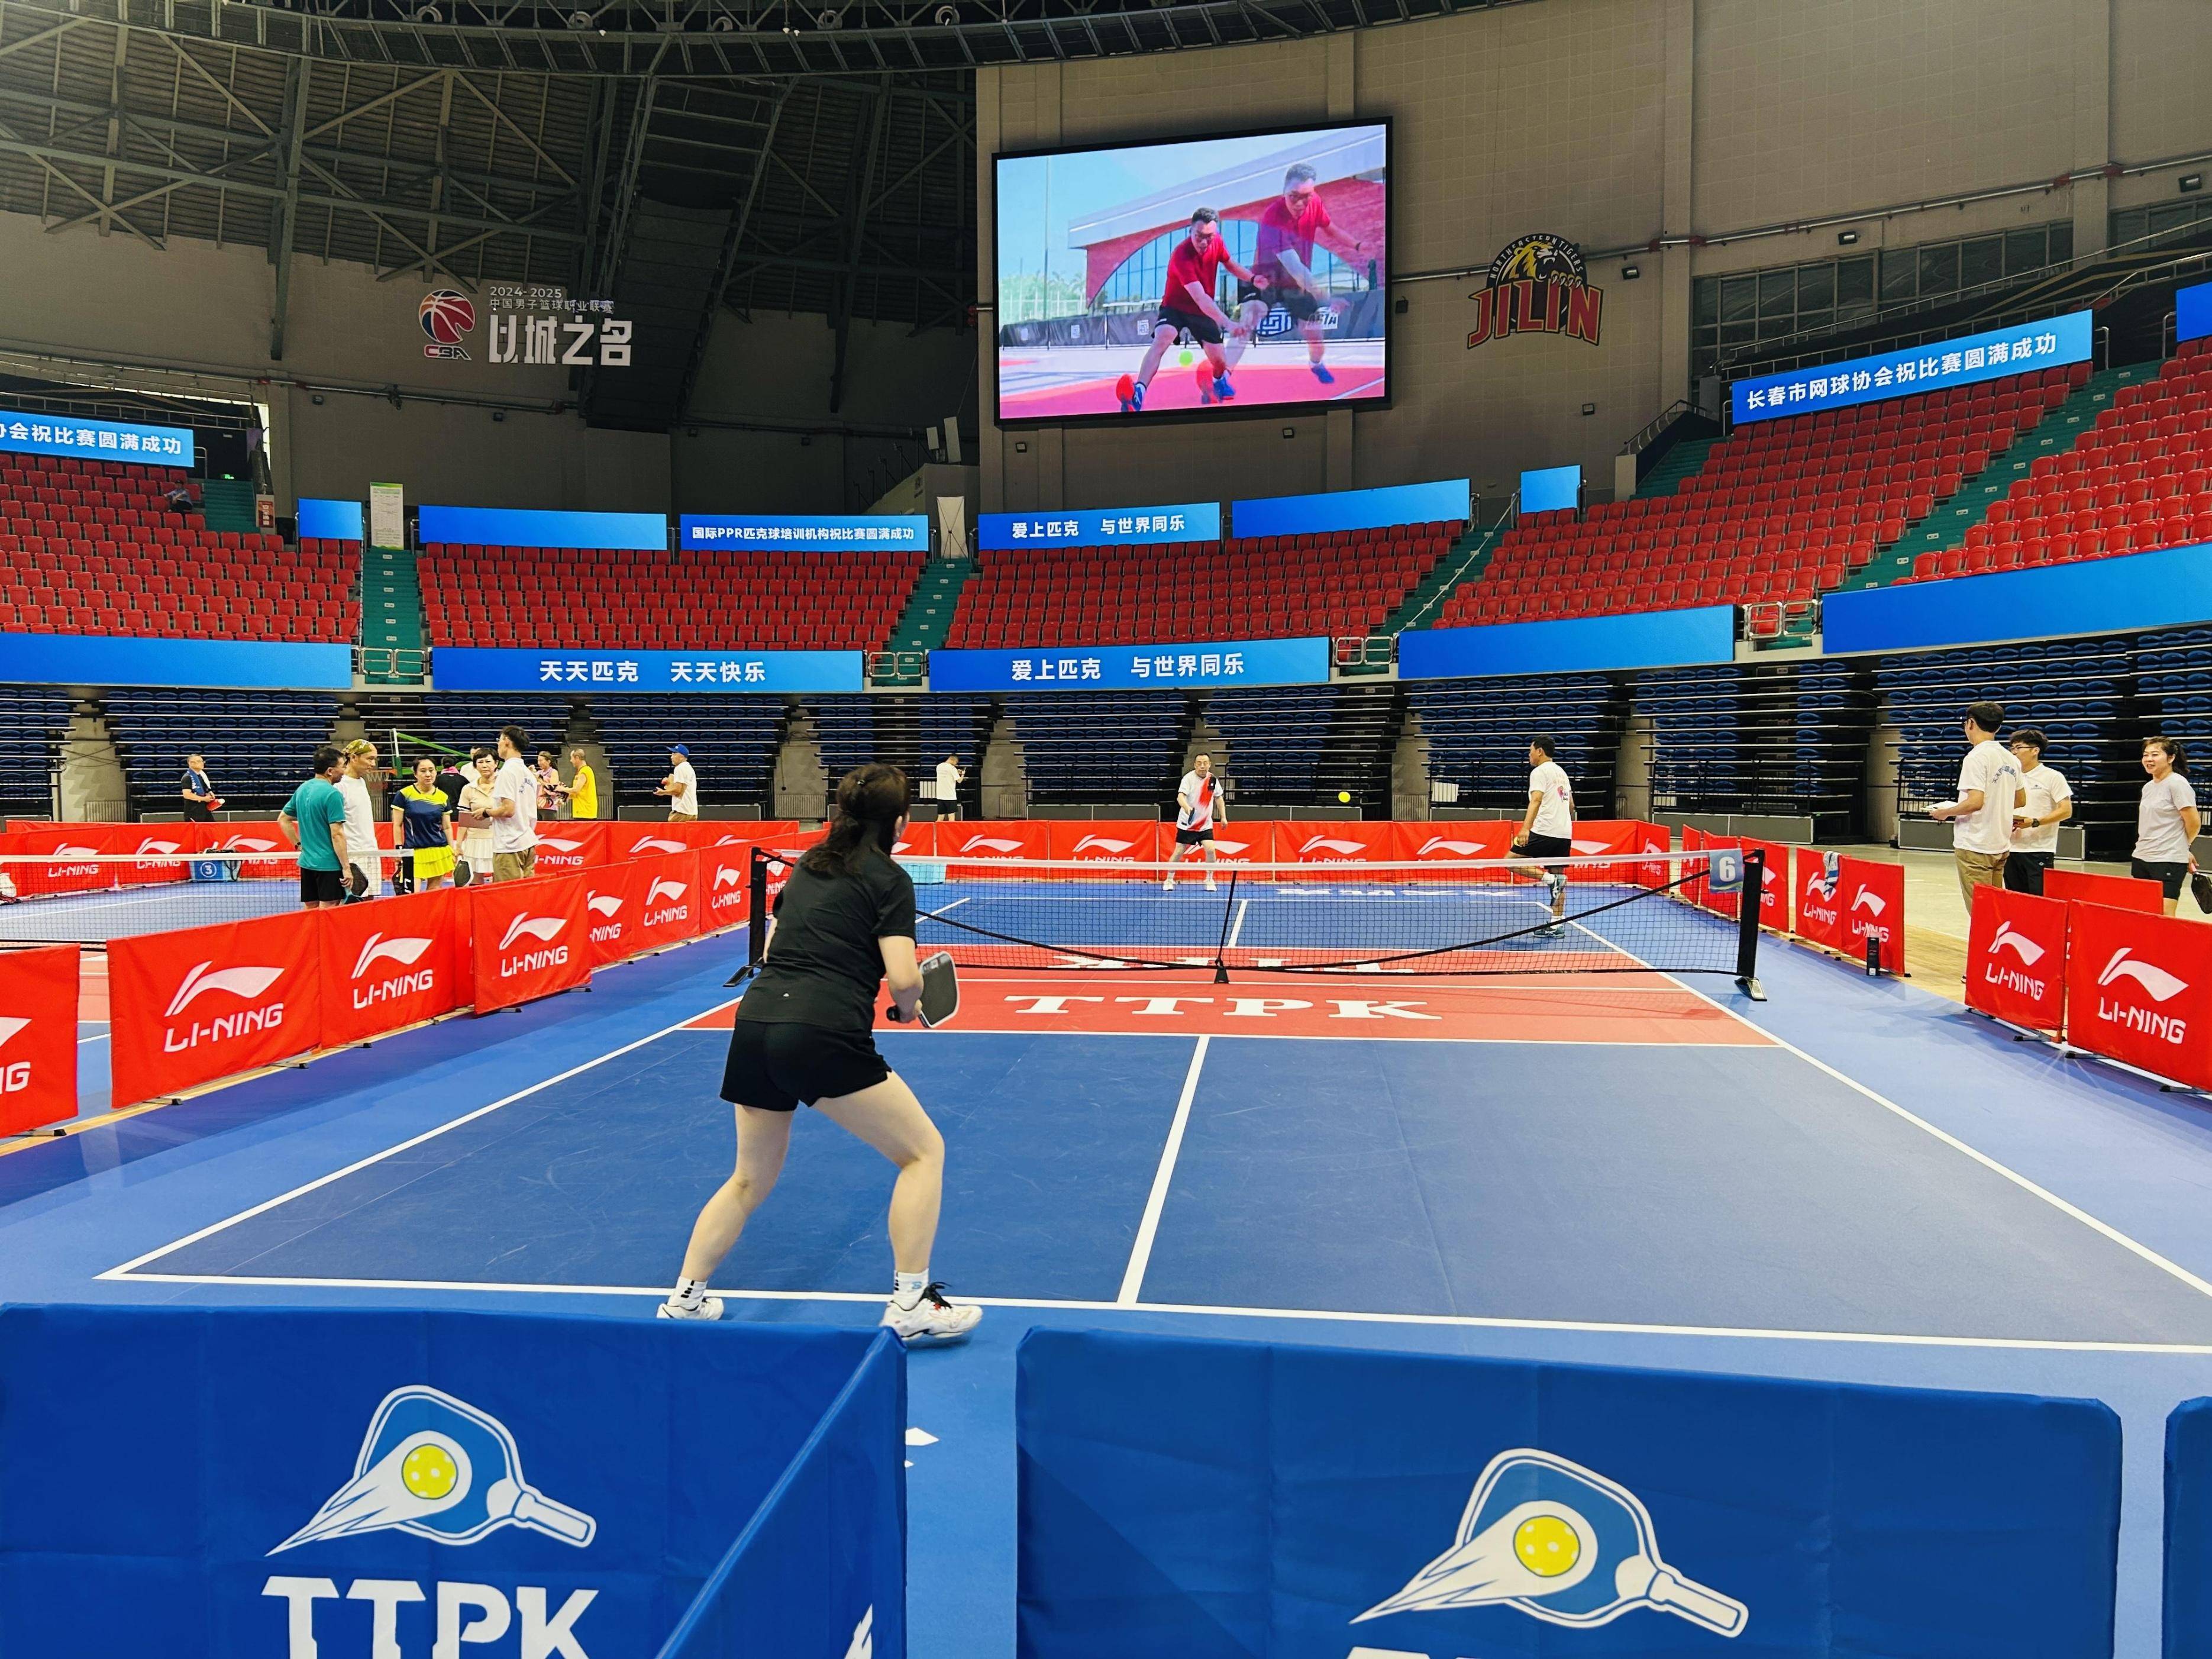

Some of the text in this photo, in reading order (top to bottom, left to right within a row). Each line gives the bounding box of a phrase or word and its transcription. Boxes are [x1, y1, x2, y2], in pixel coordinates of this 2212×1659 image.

[1559, 241, 1583, 272] TIGERS
[1467, 279, 1603, 349] JILIN
[424, 344, 472, 361] CBA
[489, 315, 633, 366] 以城之名
[1746, 333, 2057, 411] 长春市网球协会祝比赛圆满成功
[692, 527, 914, 540] 国际PPR匹克球培训机构祝比赛圆满成功
[1012, 514, 1185, 538] 爱上匹克 与世界同乐
[540, 660, 766, 683] 天天匹克 天天快乐
[1012, 653, 1244, 681] 爱上匹克 与世界同乐
[48, 864, 99, 877] LI-NING
[534, 855, 584, 866] I-NING
[1719, 857, 1736, 882] 6
[712, 890, 741, 909] LI-NING
[644, 905, 687, 927] LI-NING
[1803, 902, 1837, 925] LI-NING
[501, 945, 568, 977] LI-NING
[353, 969, 433, 1009] LI-NING
[1985, 962, 2045, 1001] LI-NING
[1004, 995, 1443, 1020] TTPK
[2097, 996, 2187, 1045] LI-NING
[164, 1002, 285, 1053] LI-NING
[262, 1576, 599, 1659] TTPK
